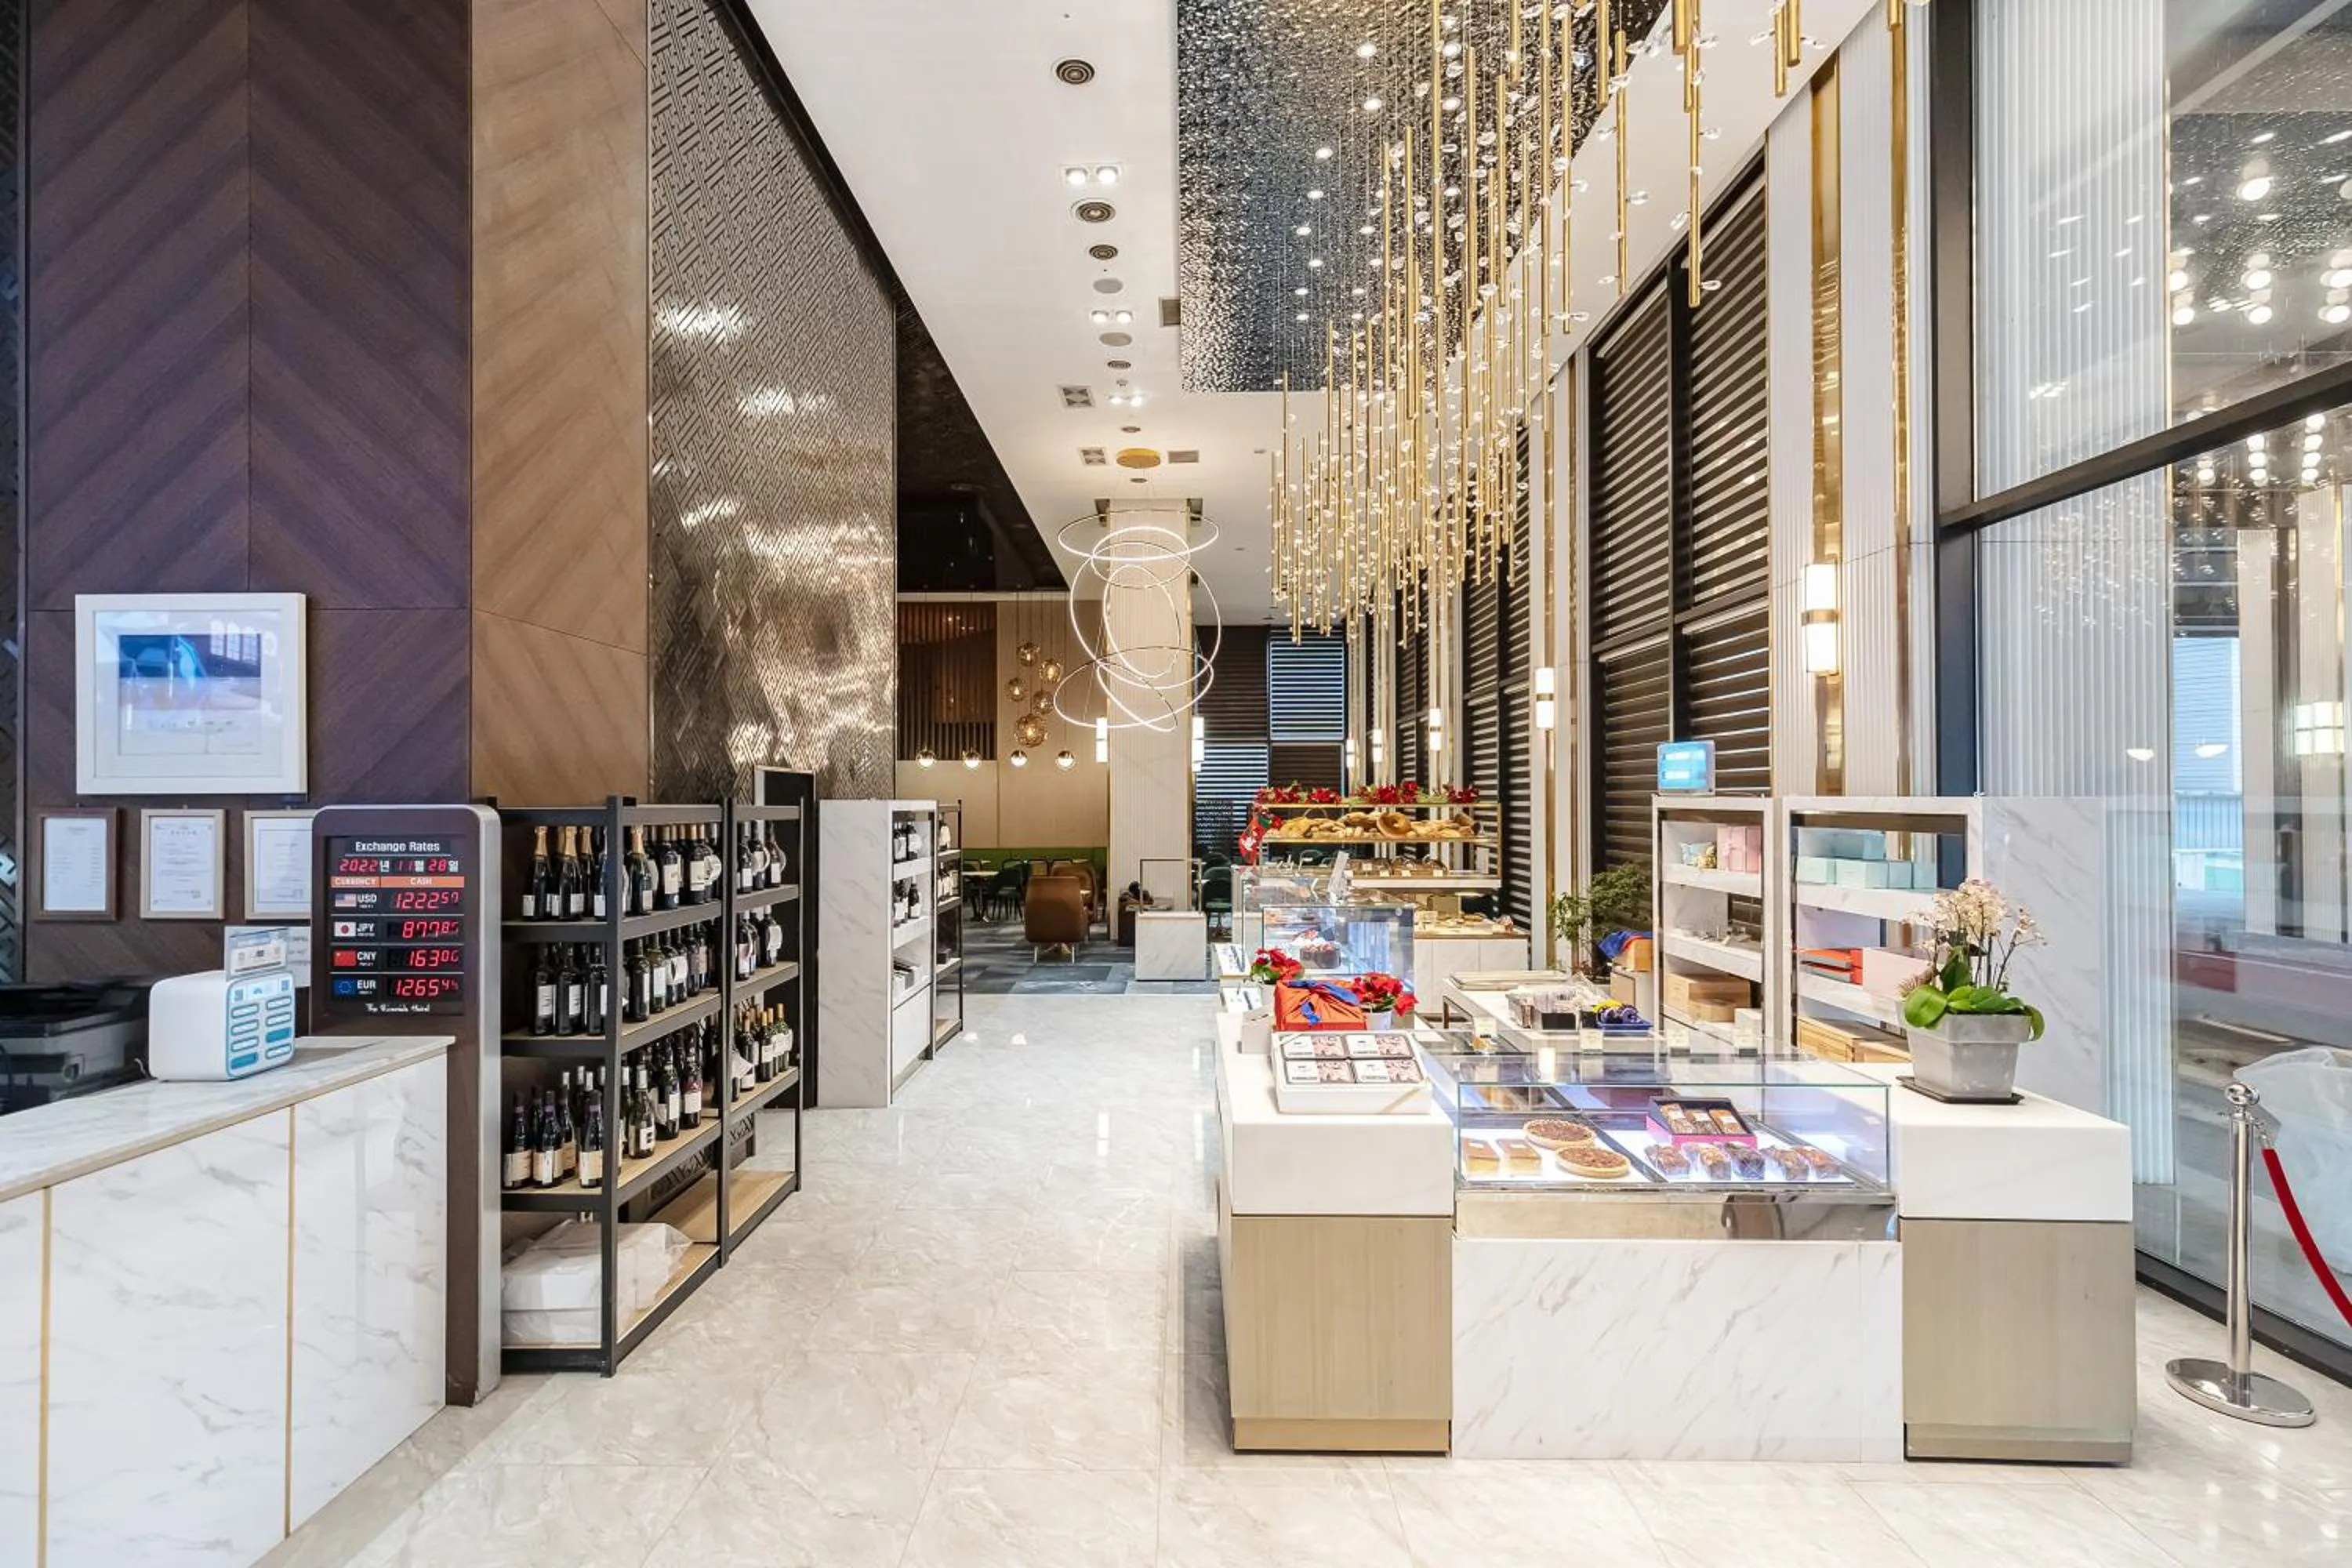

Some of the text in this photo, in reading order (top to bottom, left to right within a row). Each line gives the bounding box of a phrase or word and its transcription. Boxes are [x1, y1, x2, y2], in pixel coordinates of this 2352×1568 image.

[355, 841, 440, 852] Exchange Rates
[357, 894, 377, 903] USD
[357, 923, 375, 932] JPY
[357, 951, 377, 960] CNY
[357, 979, 376, 989] EUR
